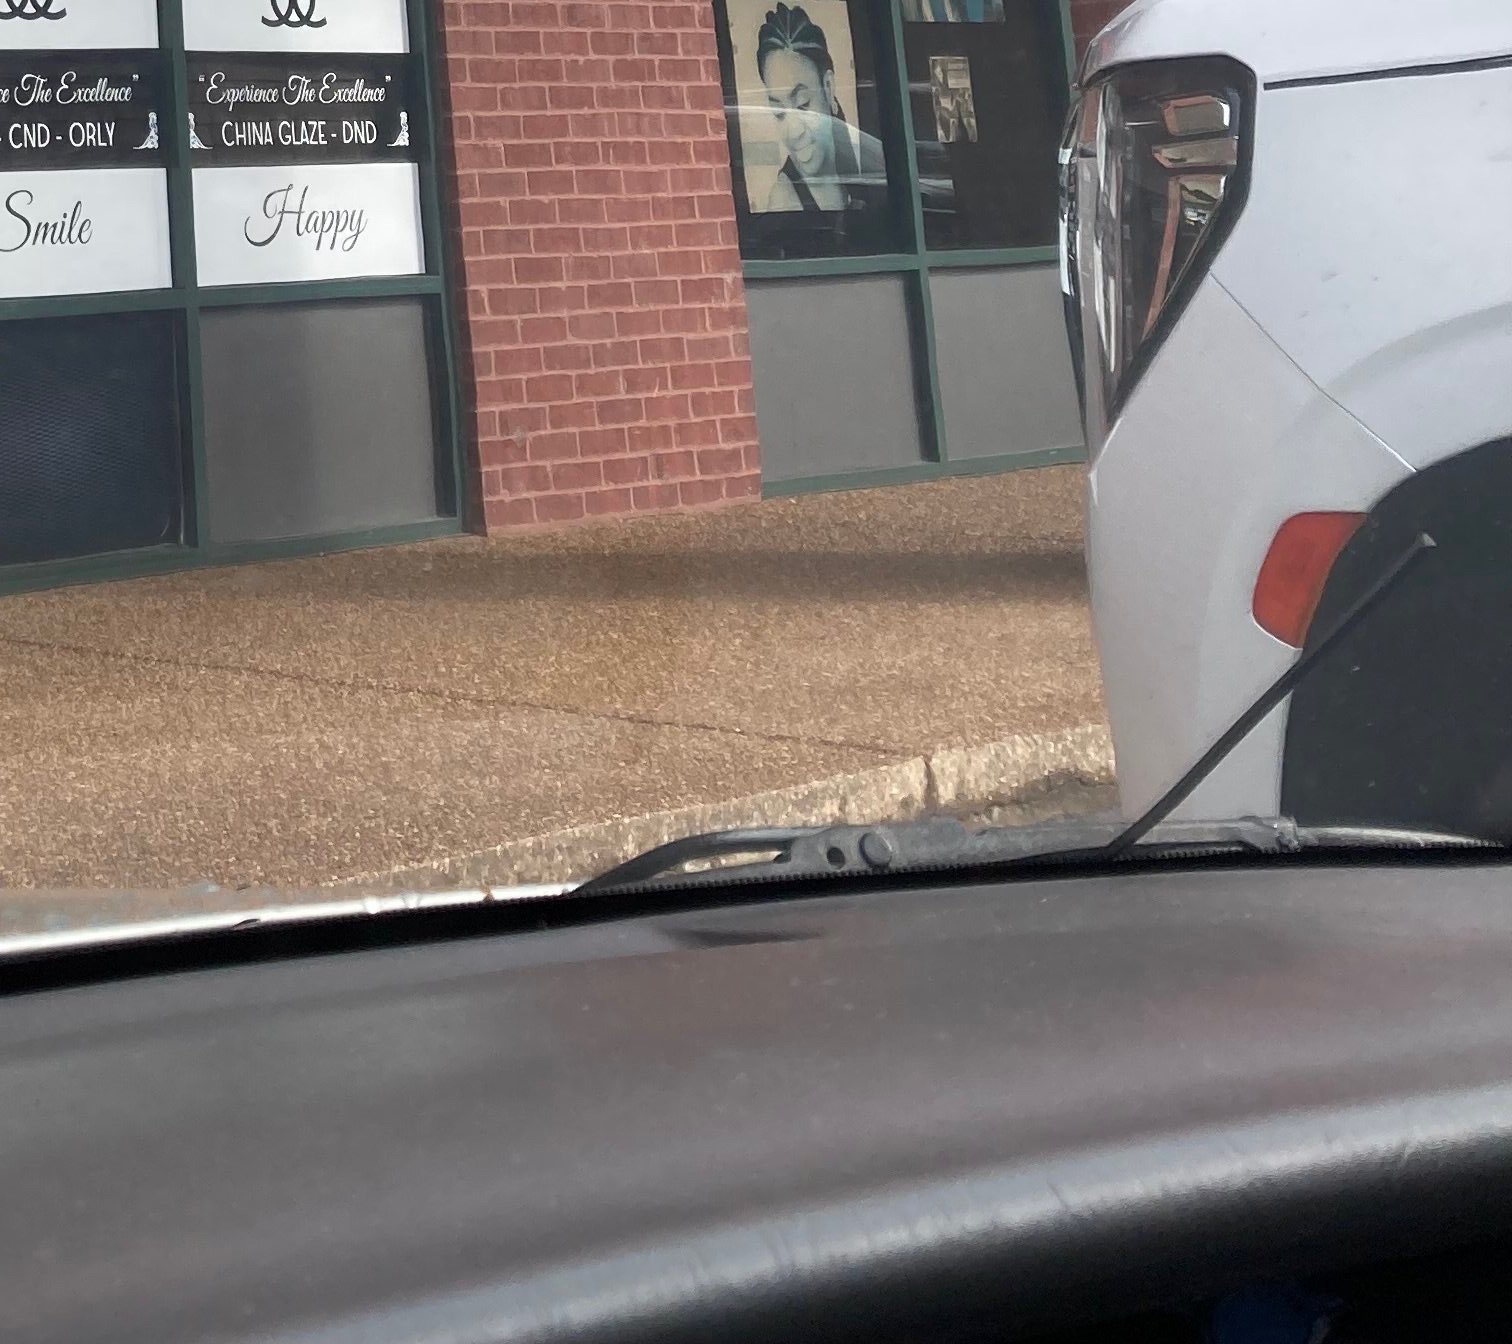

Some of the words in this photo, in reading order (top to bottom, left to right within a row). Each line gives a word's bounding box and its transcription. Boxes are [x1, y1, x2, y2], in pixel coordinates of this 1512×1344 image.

[14, 73, 53, 106] The
[282, 74, 317, 105] The
[8, 123, 50, 149] CND
[69, 122, 116, 148] ORLY
[221, 121, 274, 146] CHINA
[278, 120, 328, 146] GLAZE
[342, 120, 377, 144] DND
[244, 183, 367, 251] Happy
